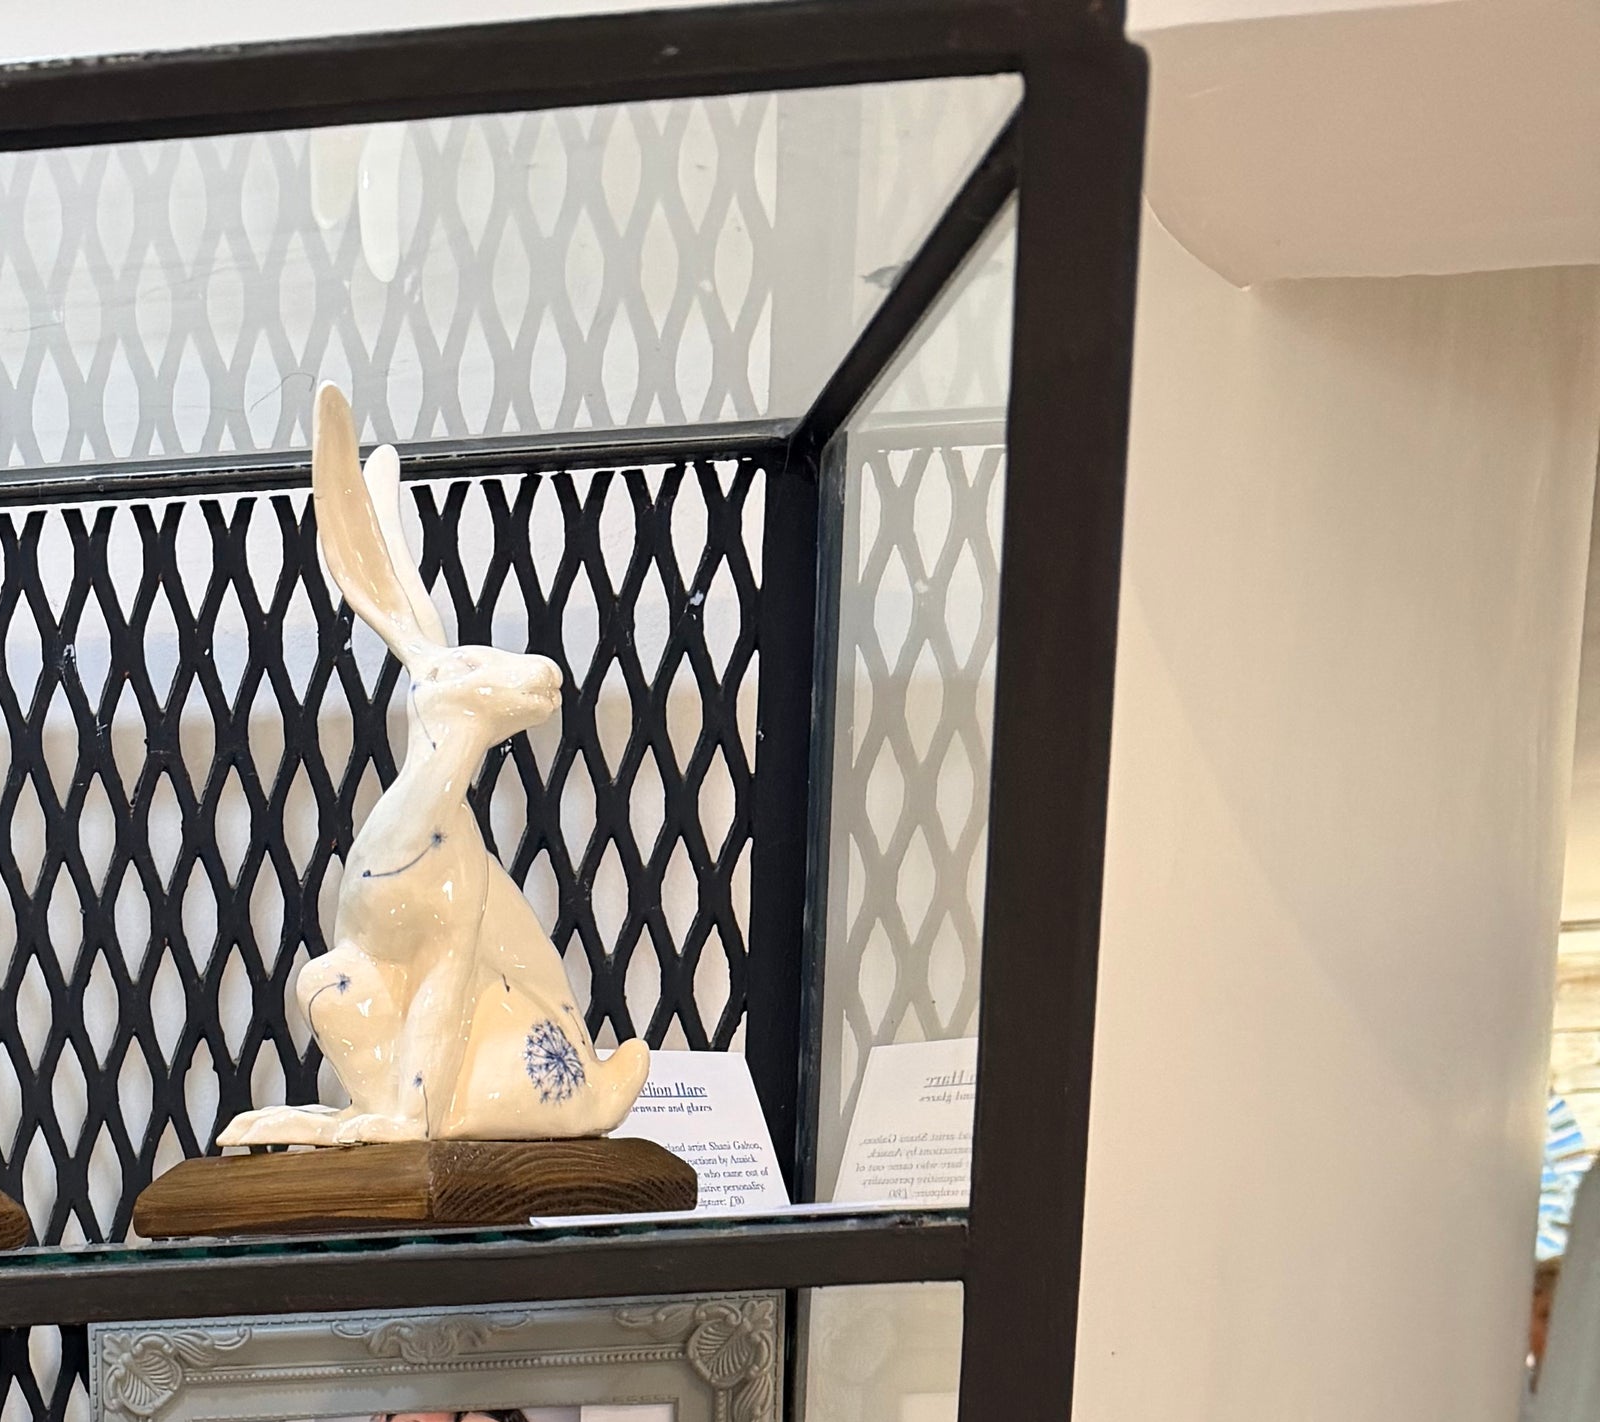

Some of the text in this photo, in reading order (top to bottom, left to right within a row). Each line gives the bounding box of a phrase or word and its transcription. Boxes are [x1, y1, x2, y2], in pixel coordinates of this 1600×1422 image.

[676, 1082, 706, 1096] Hare
[668, 1103, 712, 1115] and glazes
